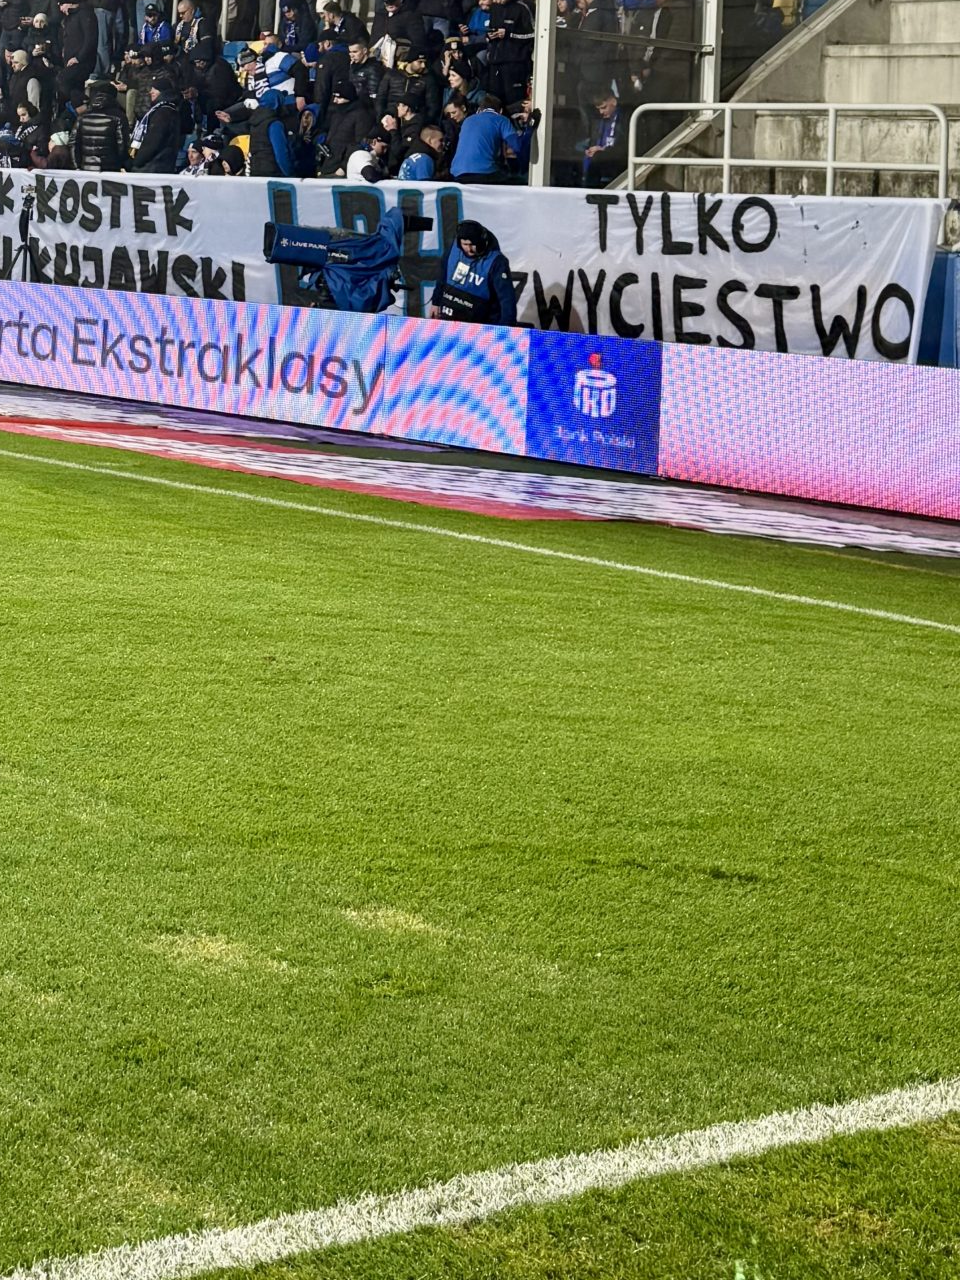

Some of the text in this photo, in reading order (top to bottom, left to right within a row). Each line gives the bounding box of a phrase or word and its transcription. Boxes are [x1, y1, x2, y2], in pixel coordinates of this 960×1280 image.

[34, 173, 193, 237] KOSTEK
[585, 192, 778, 256] TYLKO
[28, 237, 246, 302] KUJAWSKI
[291, 240, 328, 250] LIVE PARK
[71, 317, 386, 416] Ekstraklasy
